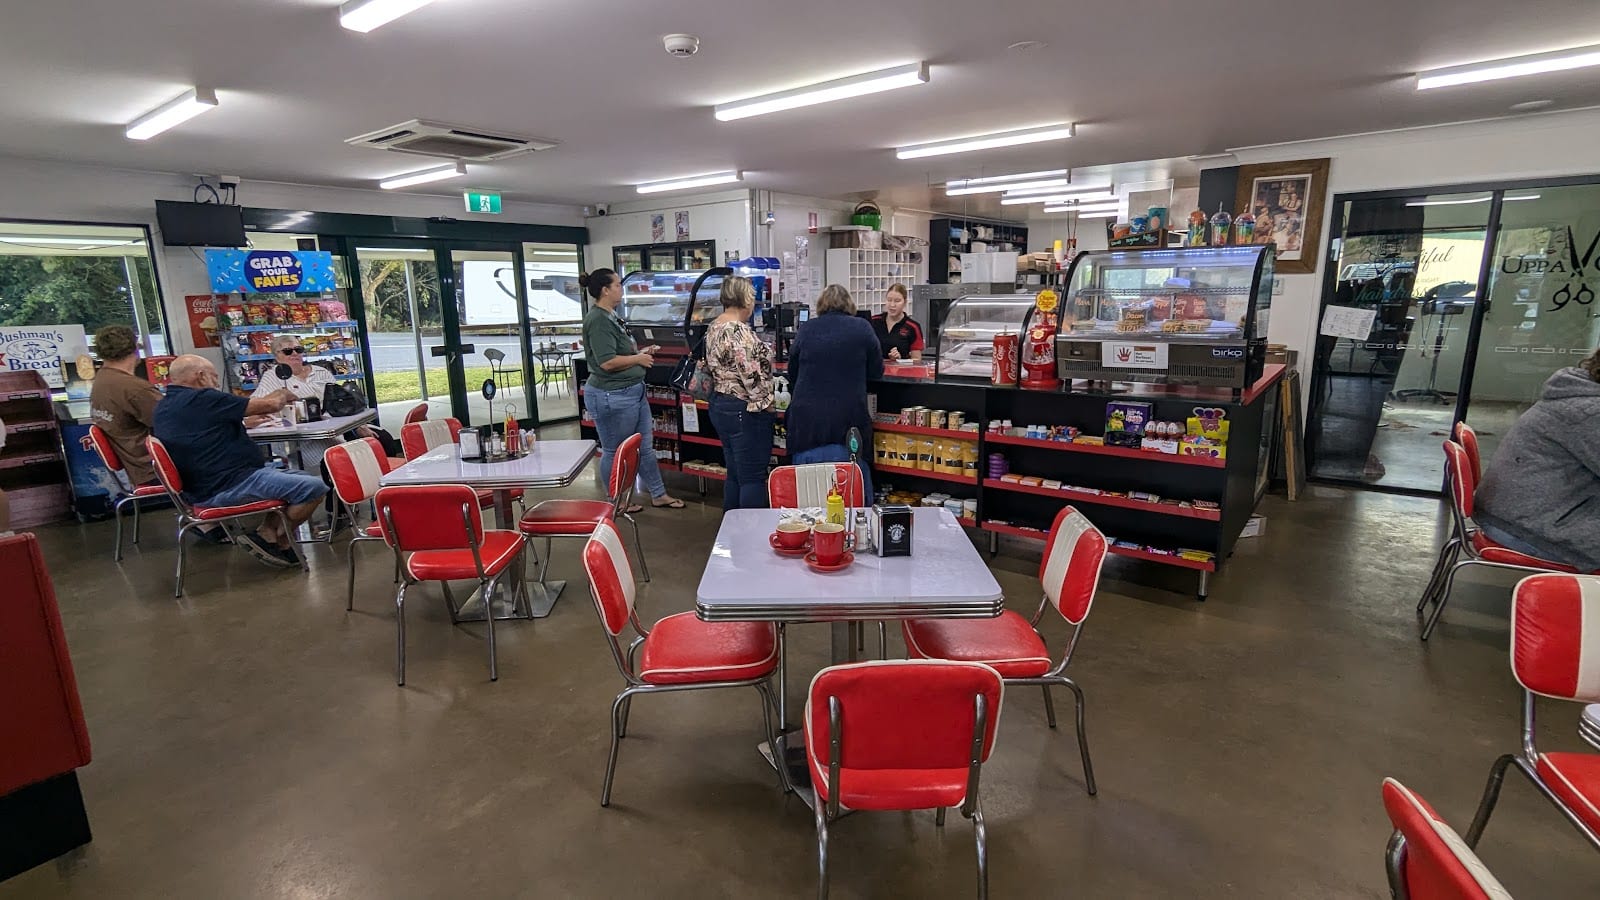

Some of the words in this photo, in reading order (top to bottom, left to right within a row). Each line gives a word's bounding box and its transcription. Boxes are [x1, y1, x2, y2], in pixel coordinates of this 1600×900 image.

[250, 256, 293, 269] GRAB
[260, 267, 289, 276] YOUR
[253, 274, 299, 288] FAVES
[1212, 348, 1243, 358] birko
[8, 356, 62, 371] Bread
